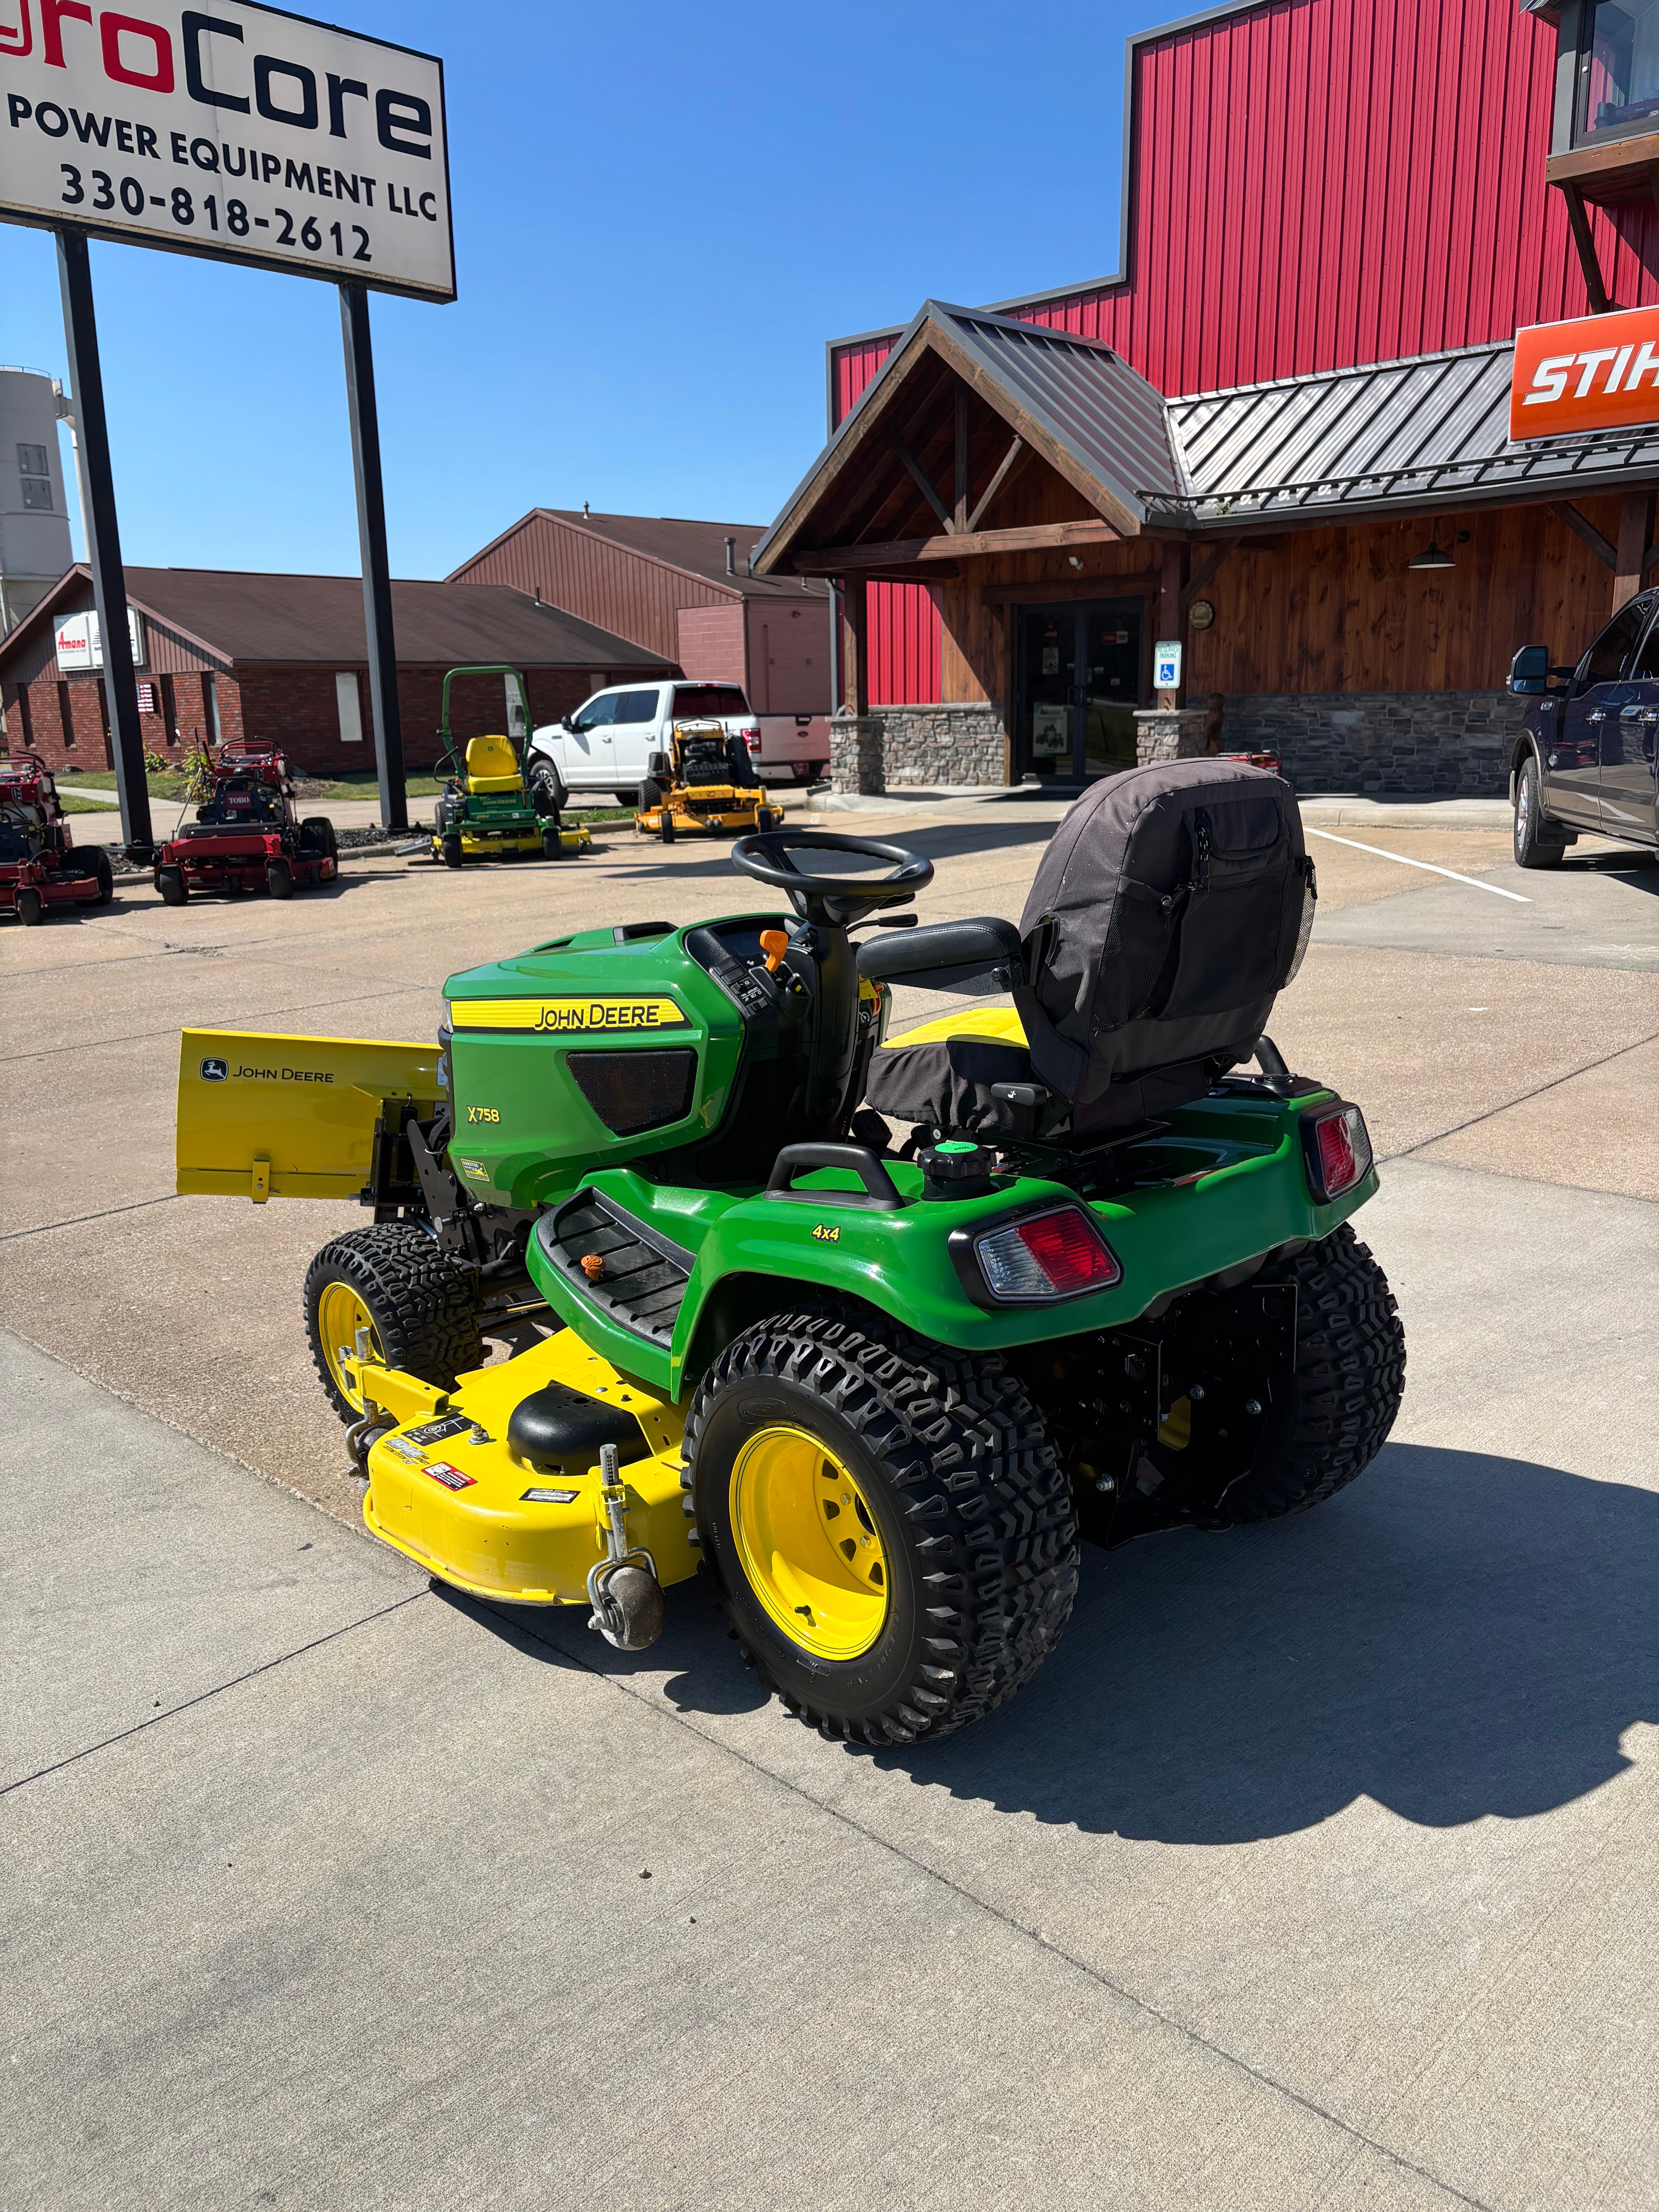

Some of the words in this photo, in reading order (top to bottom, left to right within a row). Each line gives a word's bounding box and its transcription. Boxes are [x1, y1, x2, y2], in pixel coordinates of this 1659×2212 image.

[7, 93, 161, 160] POWER
[171, 132, 376, 207] EQUIPMENT
[388, 182, 436, 221] LLC
[60, 163, 373, 261] 330-818-2612
[58, 631, 86, 649] Amana
[535, 1007, 584, 1028] JOHN
[589, 1004, 659, 1025] DEERE
[233, 1065, 277, 1079] JOHN
[281, 1068, 334, 1083] DEERE
[467, 1106, 500, 1123] X758
[812, 1224, 839, 1241] 4x4
[385, 1437, 426, 1458] EDGE
